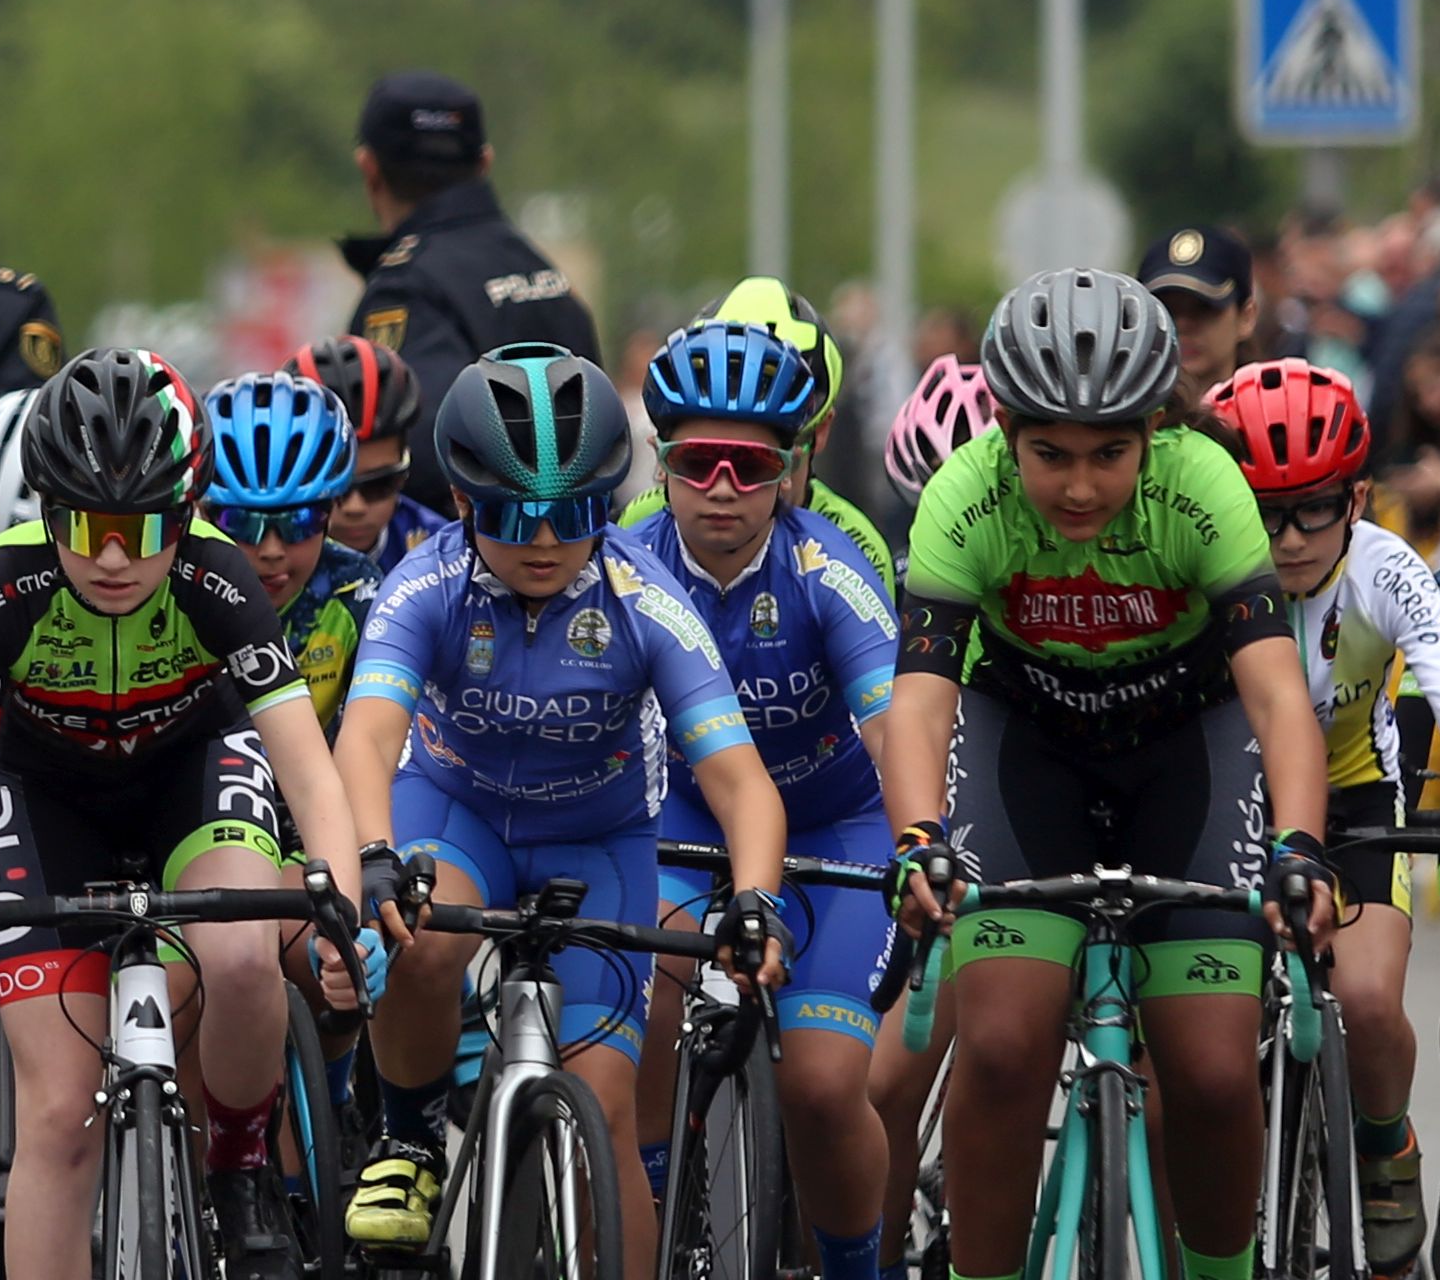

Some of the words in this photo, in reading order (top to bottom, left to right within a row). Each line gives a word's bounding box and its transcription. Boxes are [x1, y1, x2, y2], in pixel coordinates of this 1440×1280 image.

[375, 572, 440, 618] Tartiere
[861, 583, 898, 638] RURAL
[1020, 593, 1087, 628] CORTE
[1091, 589, 1159, 626] ASTUR
[239, 635, 296, 686] OV
[680, 610, 722, 667] RURAL
[735, 677, 779, 701] AD
[788, 661, 825, 696] DE
[461, 688, 591, 721] CIUDAD
[742, 684, 831, 730] EDO
